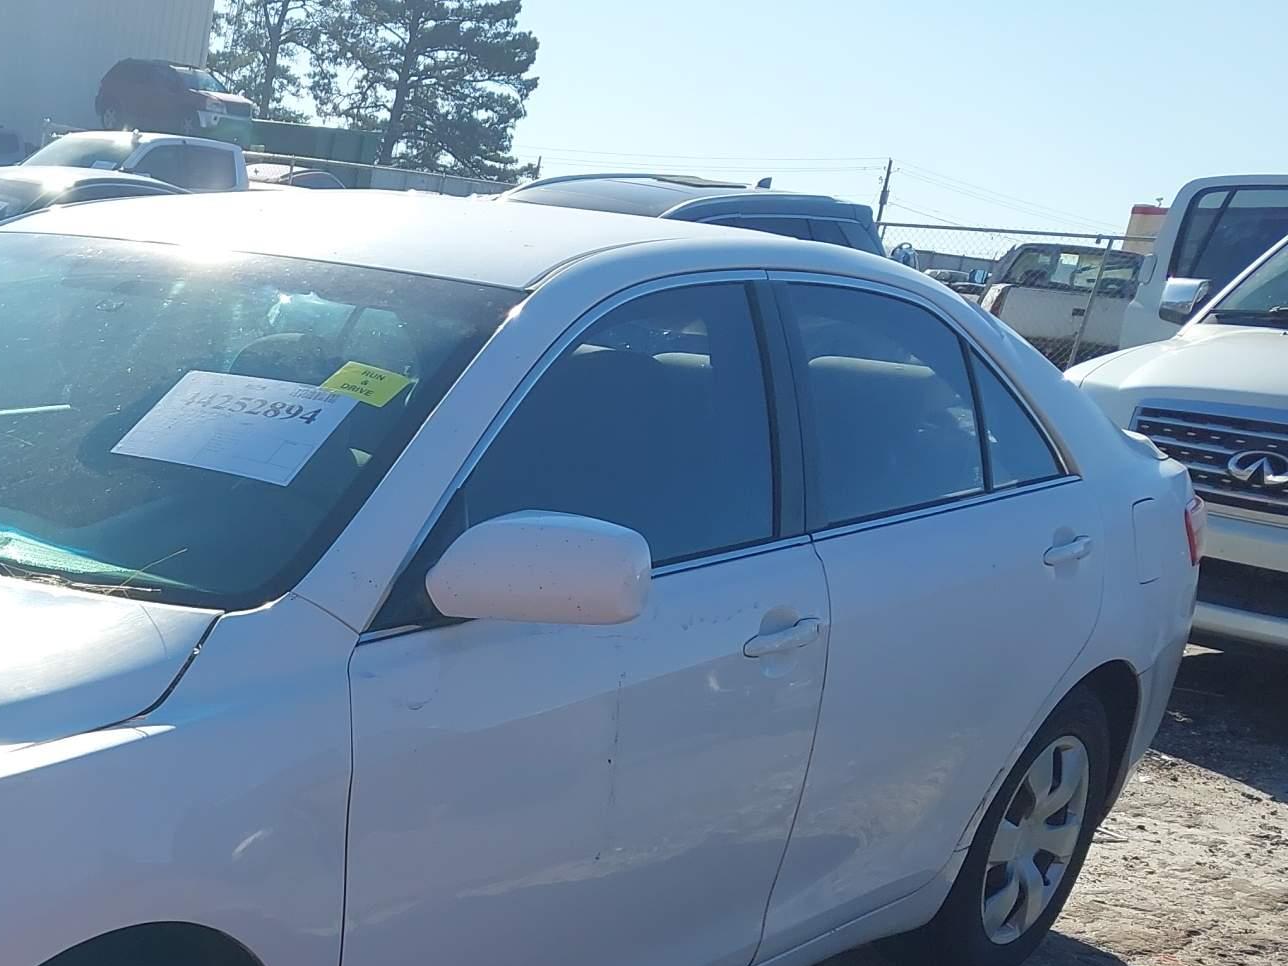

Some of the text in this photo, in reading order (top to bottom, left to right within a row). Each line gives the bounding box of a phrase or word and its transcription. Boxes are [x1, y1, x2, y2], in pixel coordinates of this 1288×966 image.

[360, 370, 387, 381] RUN
[339, 382, 374, 397] DRIVE
[183, 390, 324, 425] 44252894
